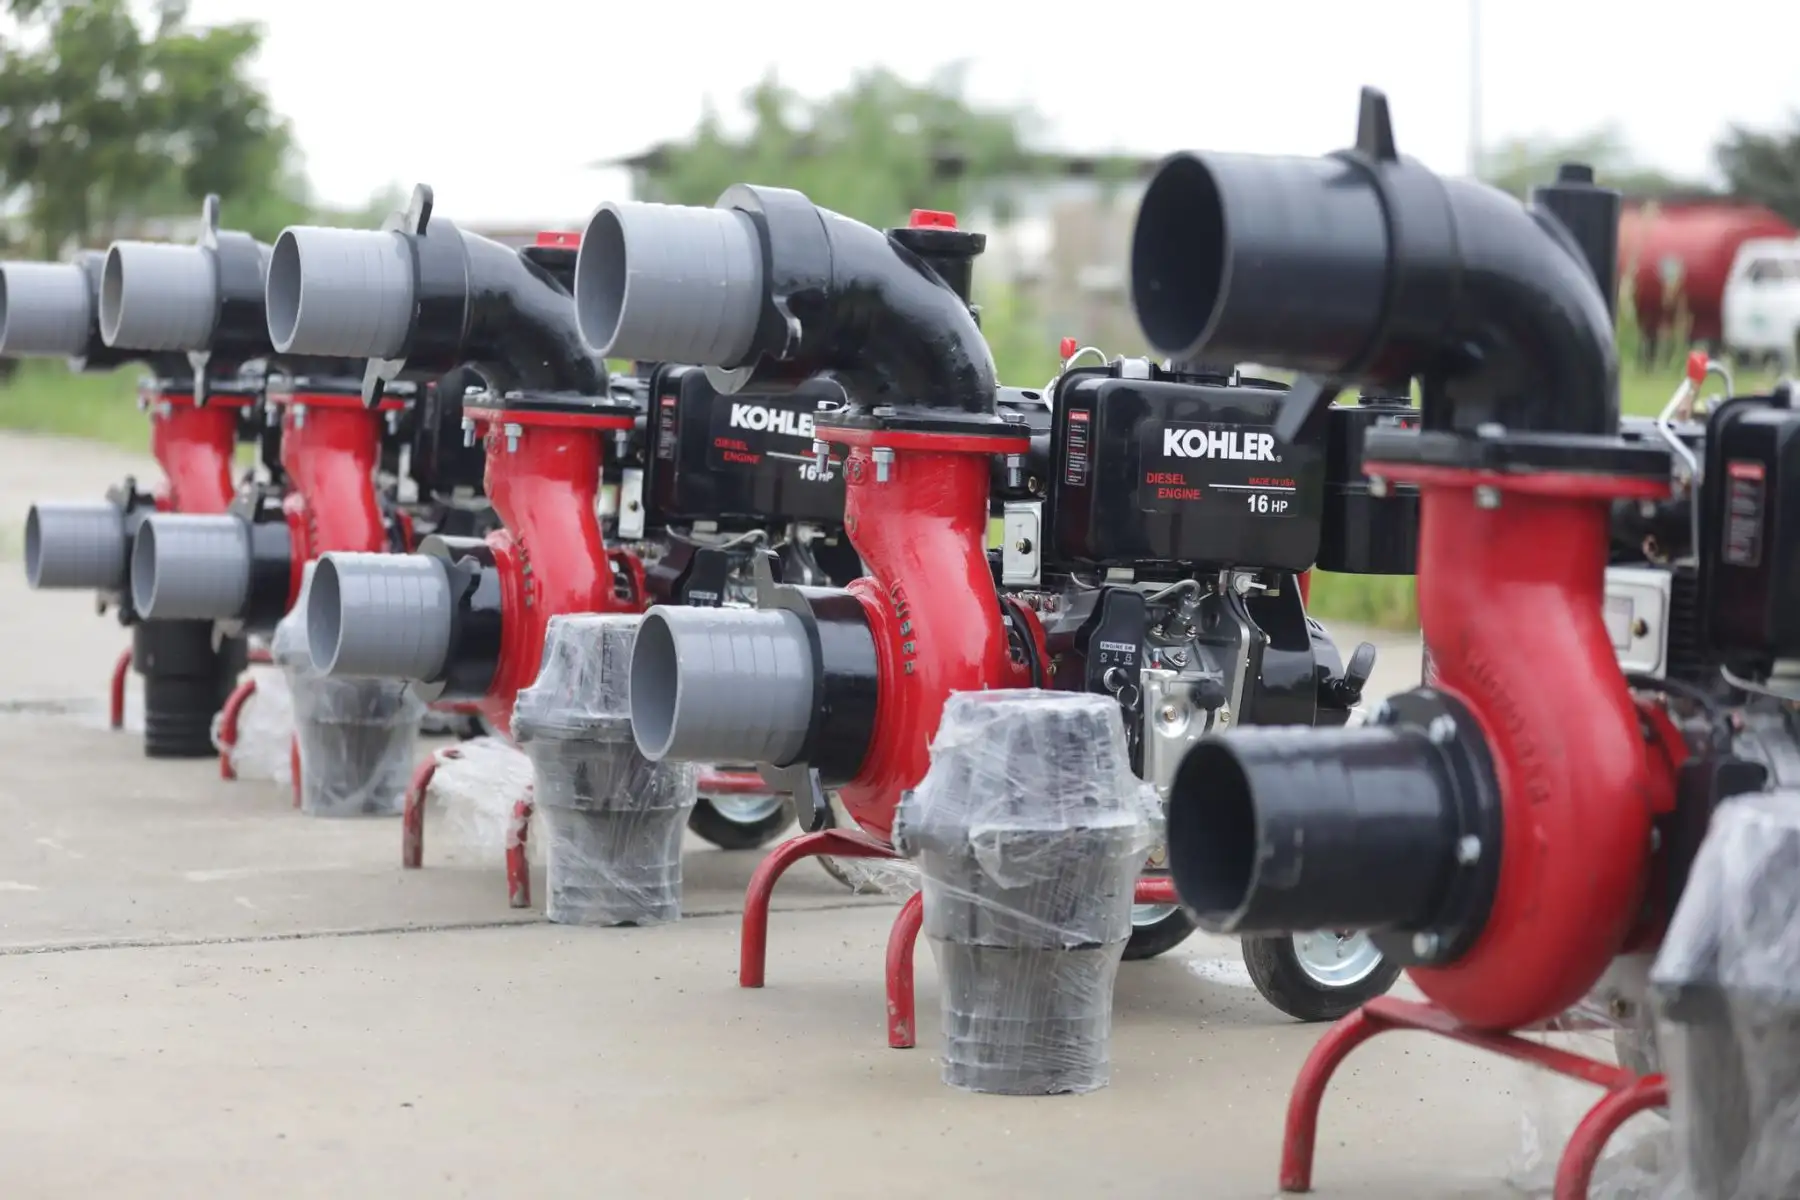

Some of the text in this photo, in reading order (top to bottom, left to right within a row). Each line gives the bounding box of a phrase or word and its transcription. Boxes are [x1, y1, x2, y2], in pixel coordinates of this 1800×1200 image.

[730, 403, 816, 439] KOHLE
[714, 437, 748, 451] DIESEL
[1163, 428, 1275, 462] KOHLER
[724, 451, 761, 465] ENGINE
[798, 463, 816, 481] 16
[1146, 472, 1187, 486] DIESEL
[1249, 477, 1296, 487] MADE IN USA
[1157, 488, 1201, 500] ENGINE
[1247, 494, 1288, 513] 16 HP
